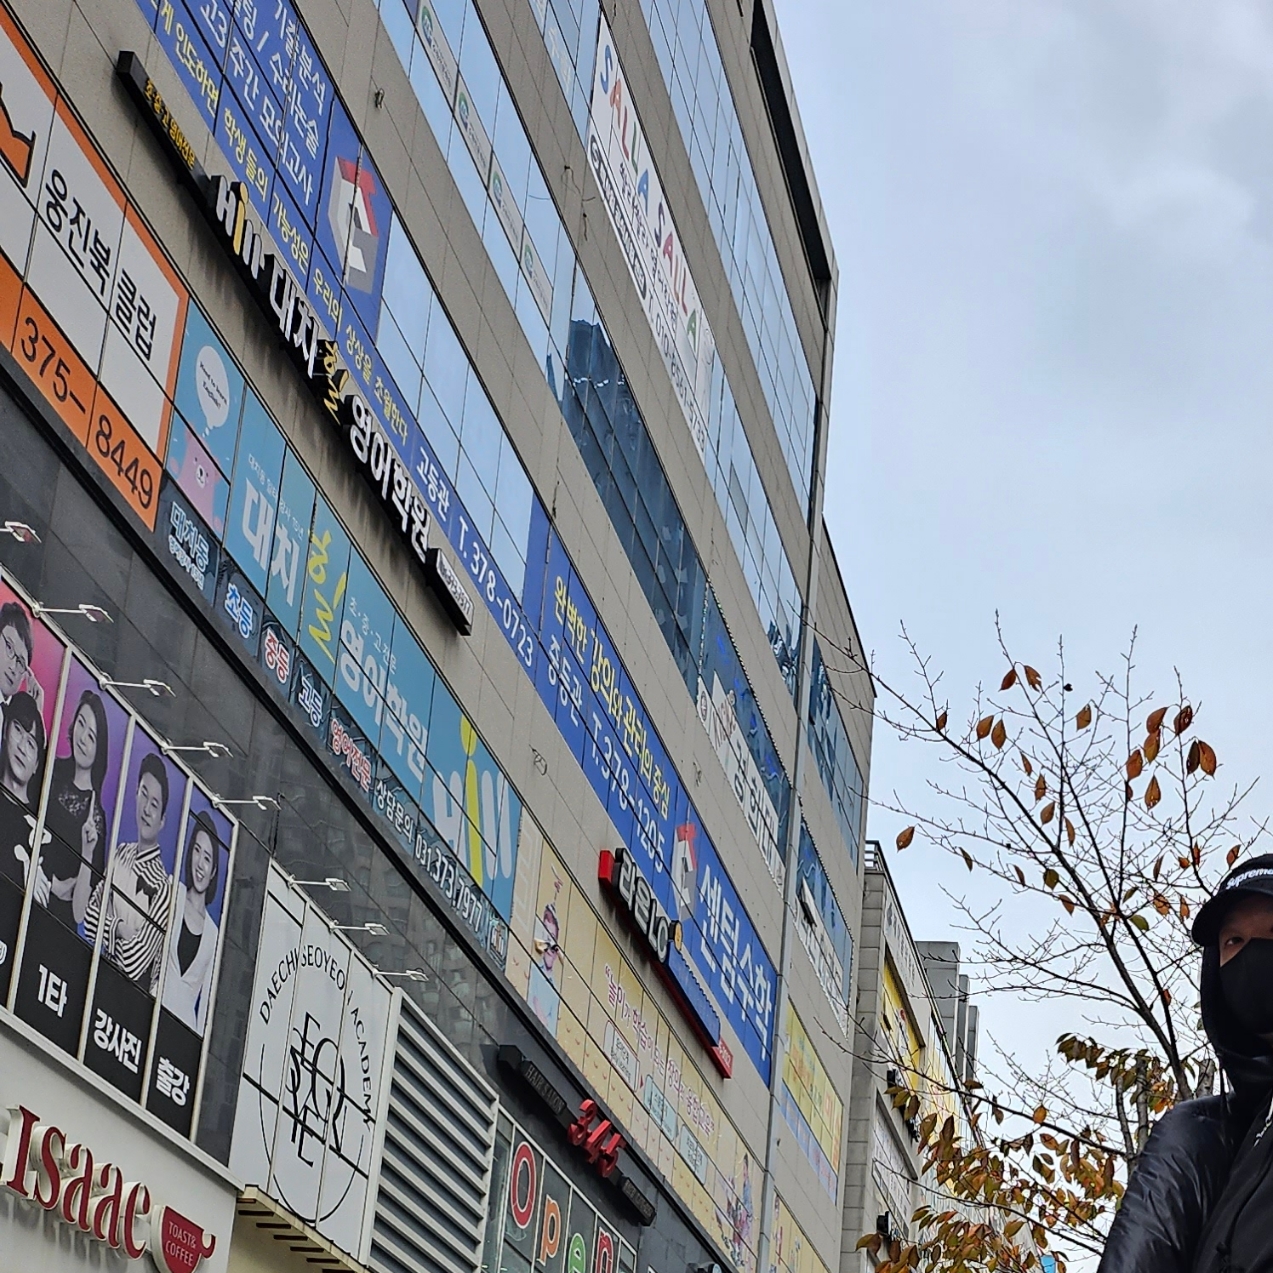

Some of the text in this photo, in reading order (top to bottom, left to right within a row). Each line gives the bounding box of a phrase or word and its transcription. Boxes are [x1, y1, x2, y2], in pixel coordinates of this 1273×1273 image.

[224, 107, 269, 202] 학생들의
[312, 265, 343, 333] 우리의
[416, 447, 451, 522] 고등관
[469, 545, 534, 668] 378-0723
[553, 575, 588, 662] 완벽한
[225, 582, 253, 639] 초등
[264, 629, 289, 684] 중등
[299, 674, 322, 728] 고등
[375, 780, 414, 843] 상담문의
[547, 634, 584, 726] 중등관
[600, 755, 665, 872] 378-1205
[38, 963, 67, 1018] 1타
[94, 1008, 142, 1074] 강사진
[156, 1054, 190, 1106] 출강
[166, 1240, 194, 1267] COFFEE
